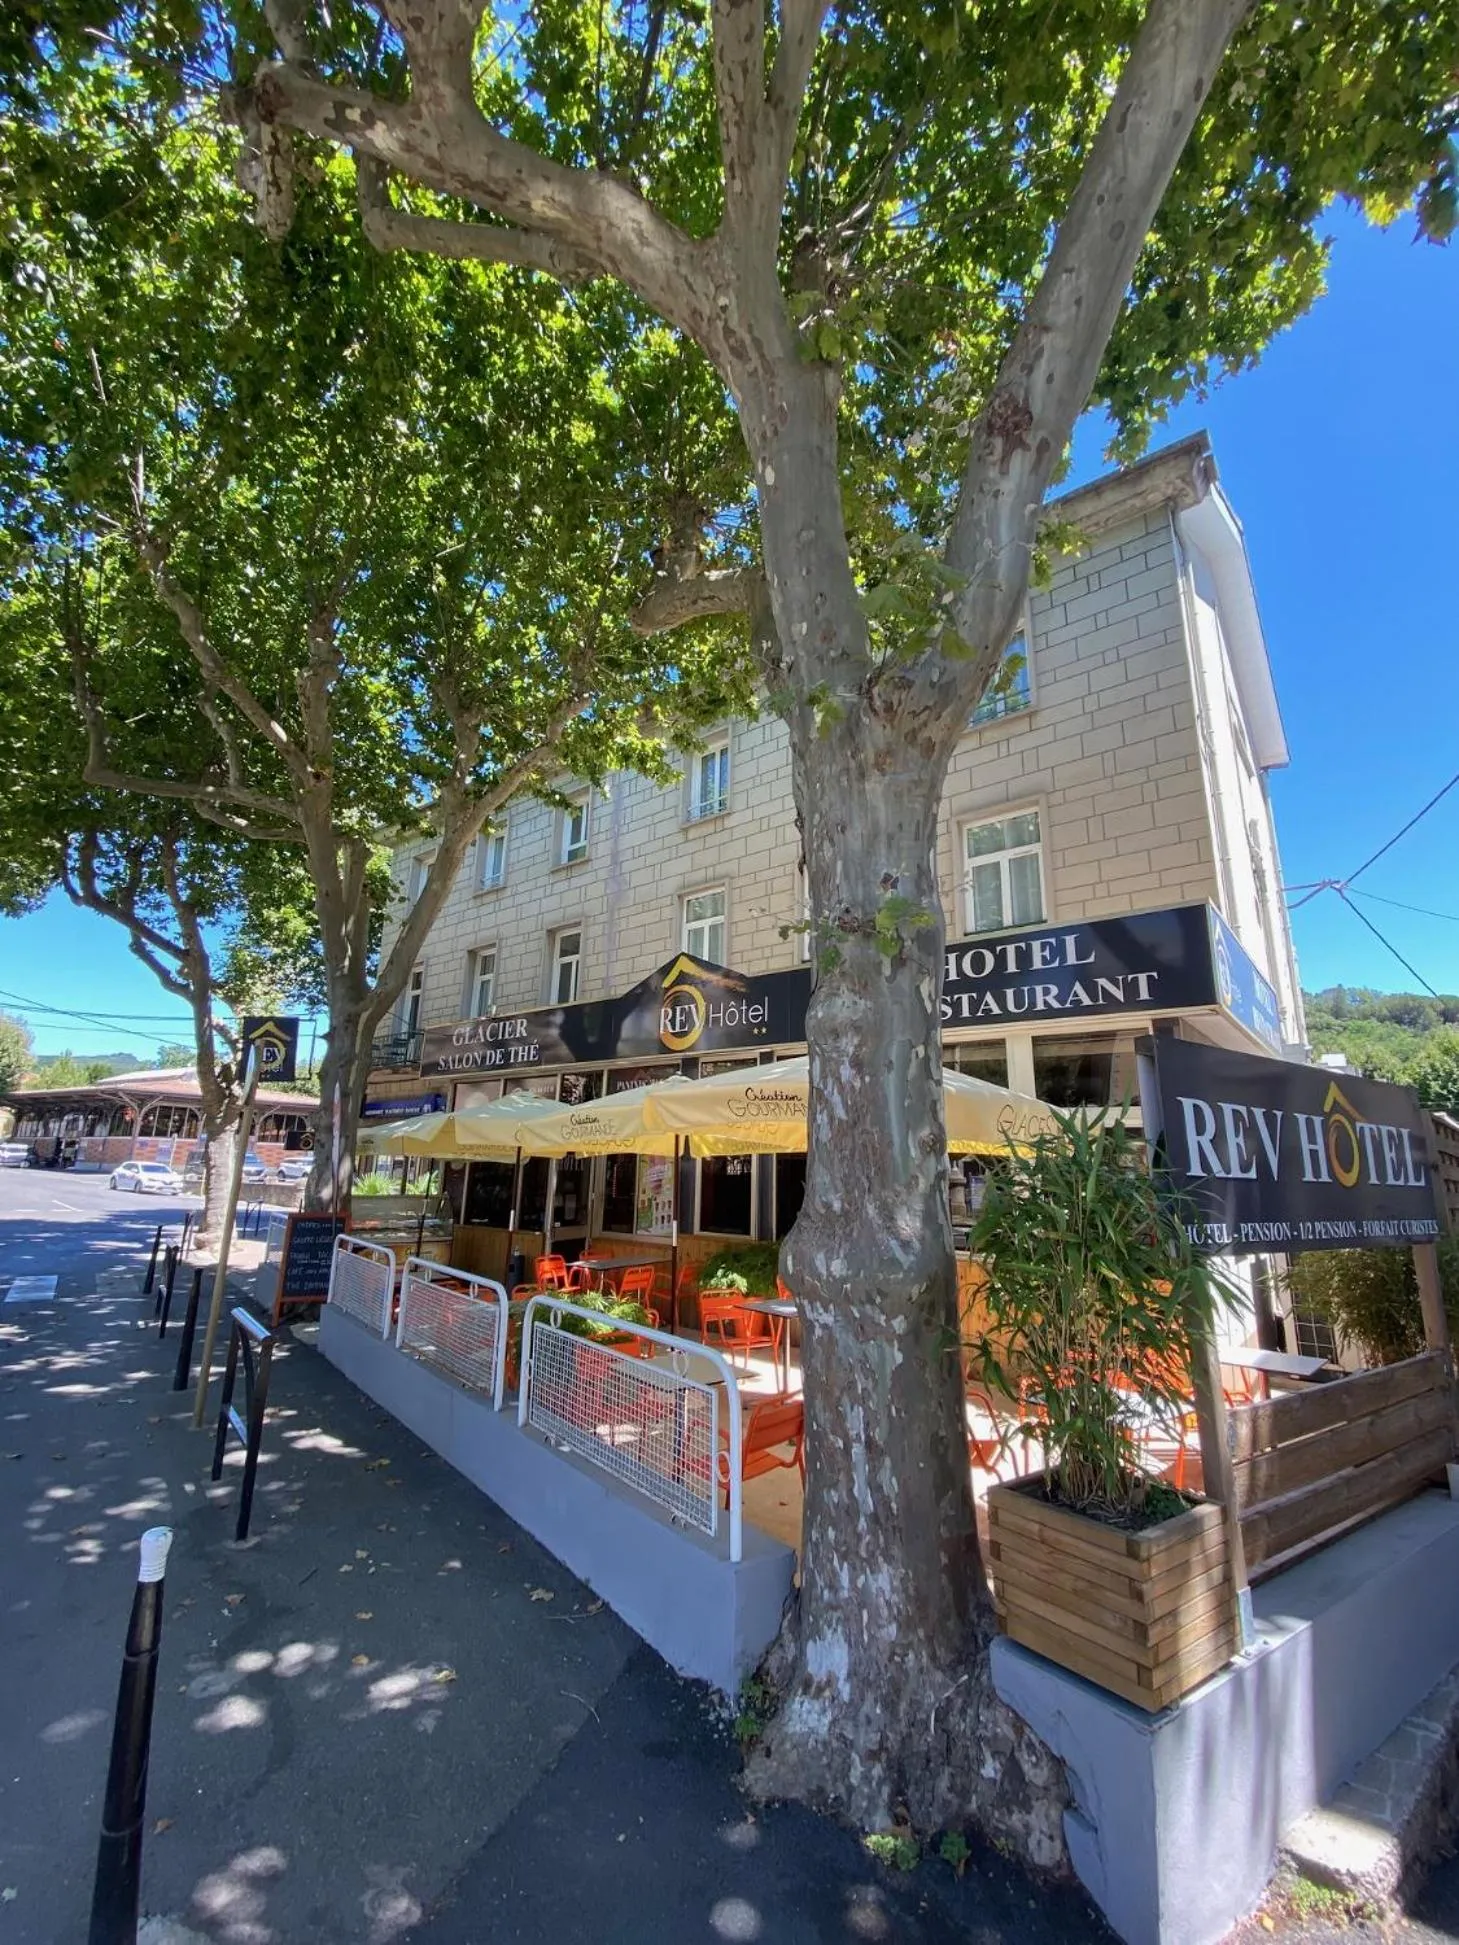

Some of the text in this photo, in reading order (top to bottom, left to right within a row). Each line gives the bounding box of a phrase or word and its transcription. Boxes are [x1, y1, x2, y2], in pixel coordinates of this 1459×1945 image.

[941, 972, 1158, 1020] STAURANT
[452, 1018, 529, 1046] GLACIER
[660, 996, 769, 1034] REV Hôtel
[437, 1039, 540, 1071] SALON DE THÉ
[1176, 1096, 1284, 1182] REV
[1240, 1222, 1291, 1242] PENSION
[1315, 1221, 1357, 1239] PENSION
